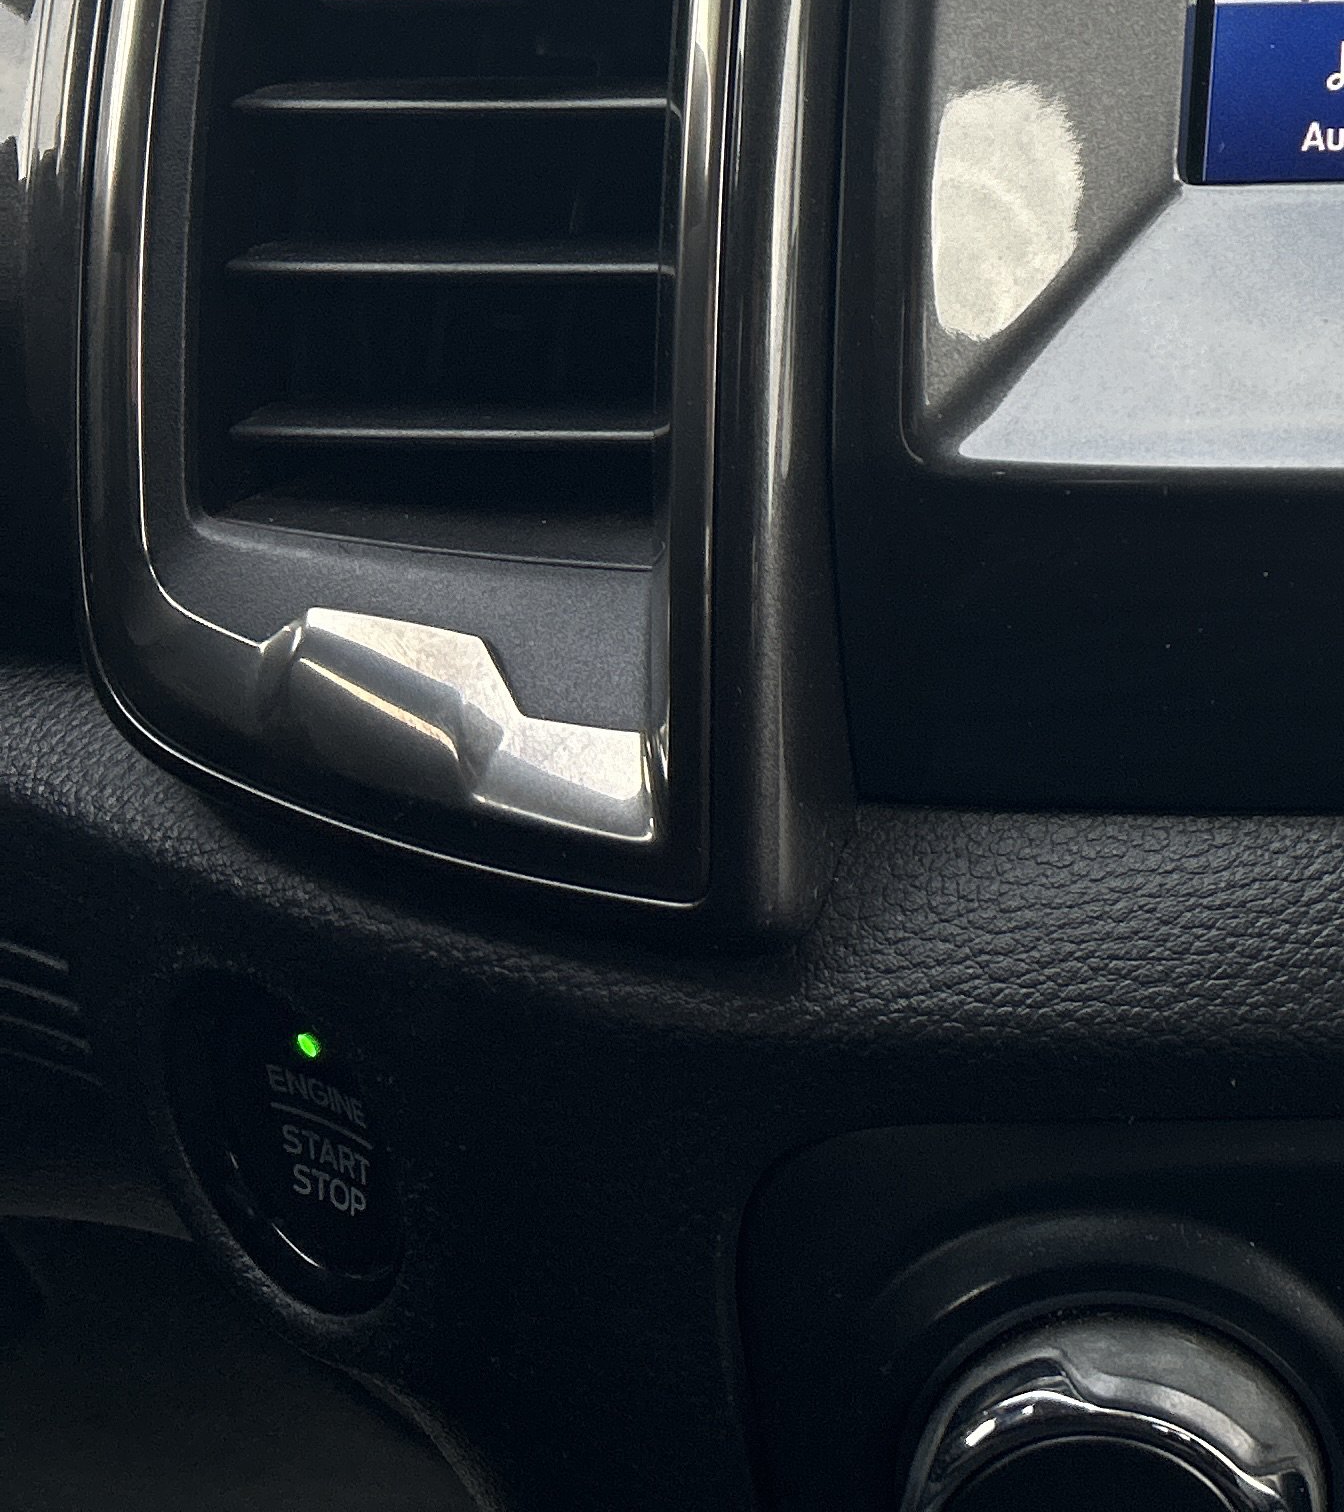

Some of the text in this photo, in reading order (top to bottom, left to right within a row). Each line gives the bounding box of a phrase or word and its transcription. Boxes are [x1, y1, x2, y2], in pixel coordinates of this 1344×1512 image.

[265, 1063, 367, 1130] ENGINE
[281, 1123, 371, 1186] START
[292, 1163, 368, 1218] STOP
